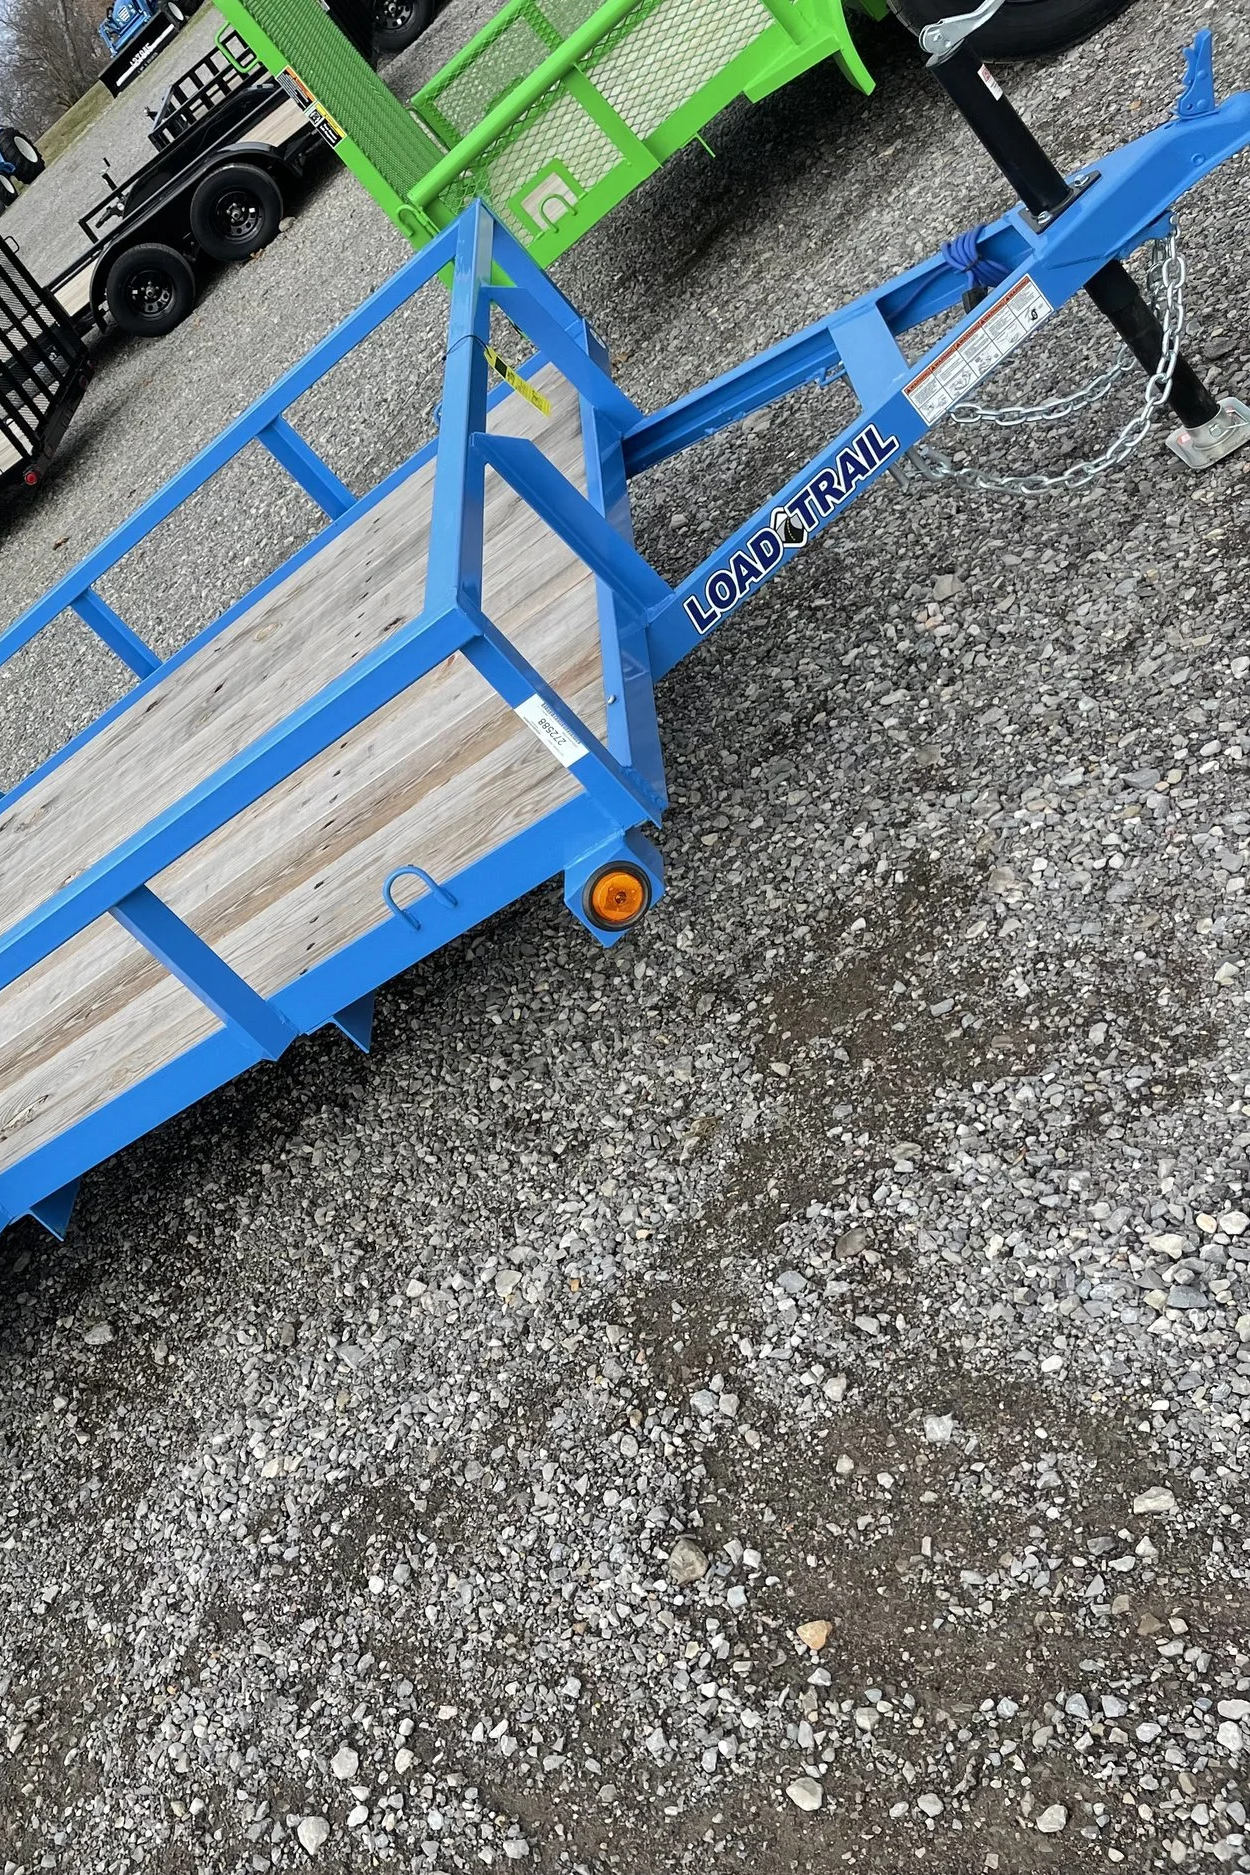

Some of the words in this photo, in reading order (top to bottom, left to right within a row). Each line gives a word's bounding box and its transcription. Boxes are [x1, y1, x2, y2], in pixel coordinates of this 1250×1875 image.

[683, 527, 784, 634] LOAD
[784, 423, 899, 532] TRAIL
[537, 718, 567, 746] 272588
